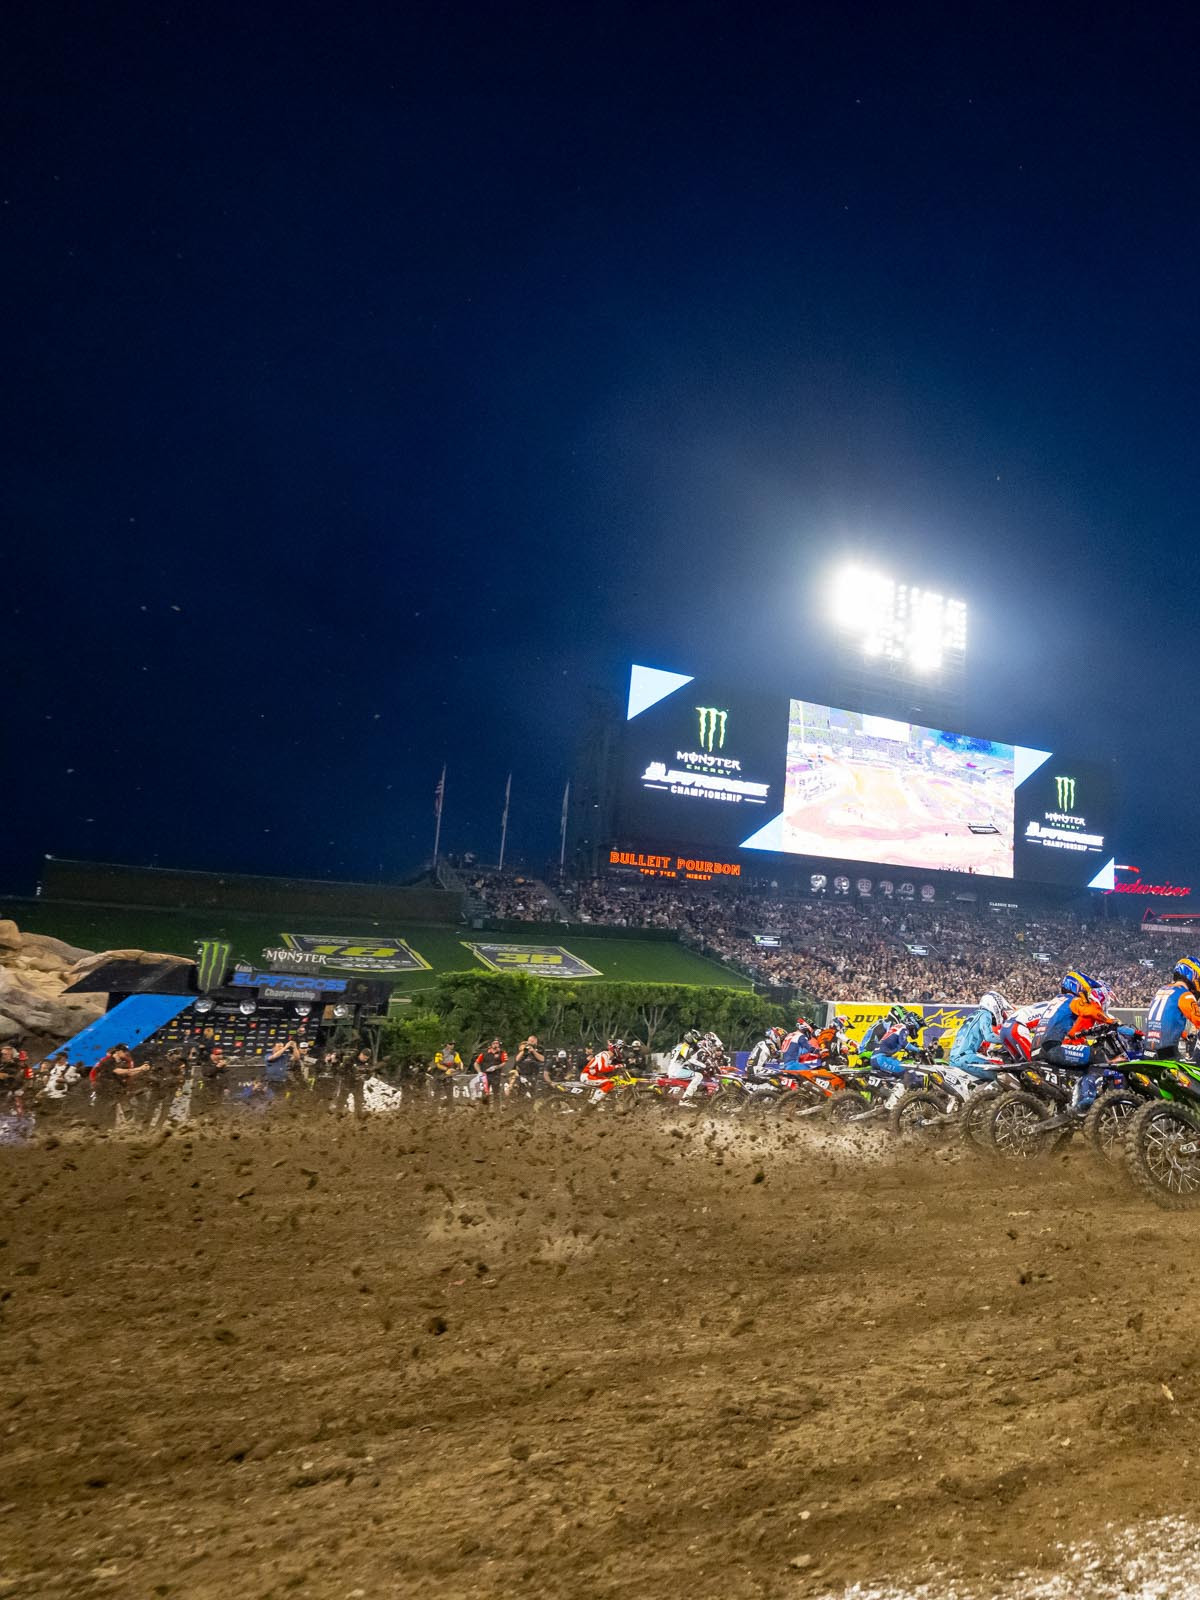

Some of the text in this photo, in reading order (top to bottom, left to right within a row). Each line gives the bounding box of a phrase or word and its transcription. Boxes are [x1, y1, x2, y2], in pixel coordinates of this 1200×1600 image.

[677, 751, 741, 771] MONSTER
[686, 764, 731, 776] ENERGY
[671, 785, 742, 802] CHAMPIONSHIP
[610, 851, 671, 868] BULLEIT
[266, 949, 327, 965] MONSTER
[264, 988, 316, 1000] Championship
[853, 1014, 886, 1023] DUN
